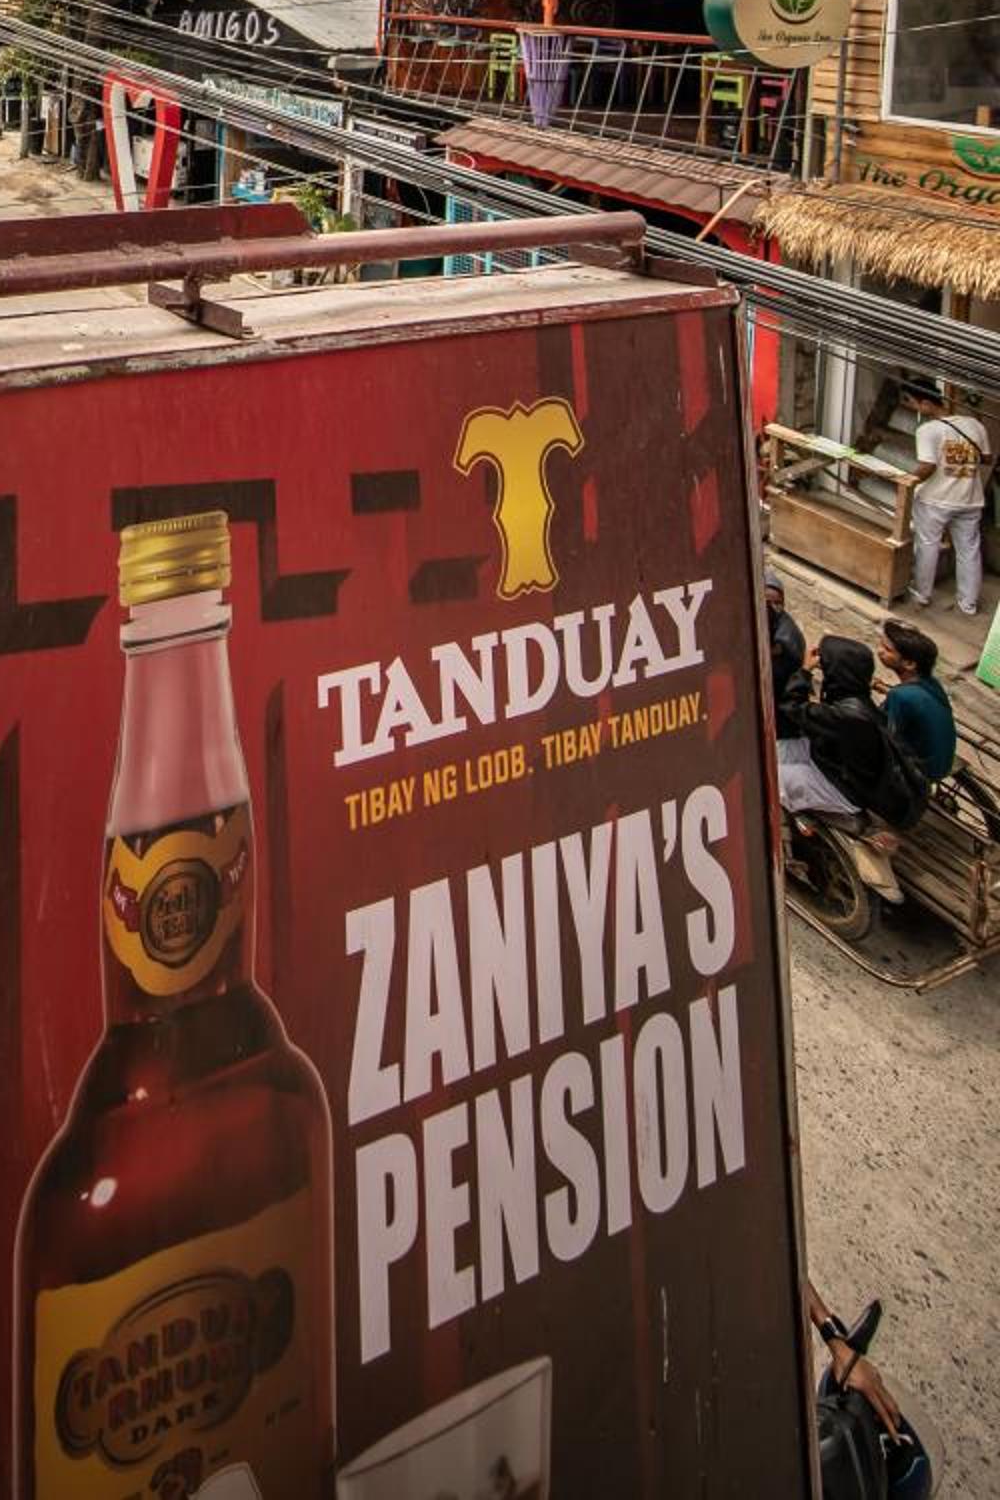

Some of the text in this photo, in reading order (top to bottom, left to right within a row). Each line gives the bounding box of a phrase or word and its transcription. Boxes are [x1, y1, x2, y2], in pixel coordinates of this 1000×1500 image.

[180, 9, 280, 45] AMIGOS
[859, 162, 906, 188] The
[318, 579, 712, 768] TANDUAY
[345, 691, 708, 831] TIBAY NG LOOB. TIBAY TANDUAY.
[345, 785, 735, 1127] ZANIYA'S
[355, 984, 745, 1365] PENSION
[70, 1298, 256, 1411] TANDU
[130, 1391, 218, 1445] DARK
